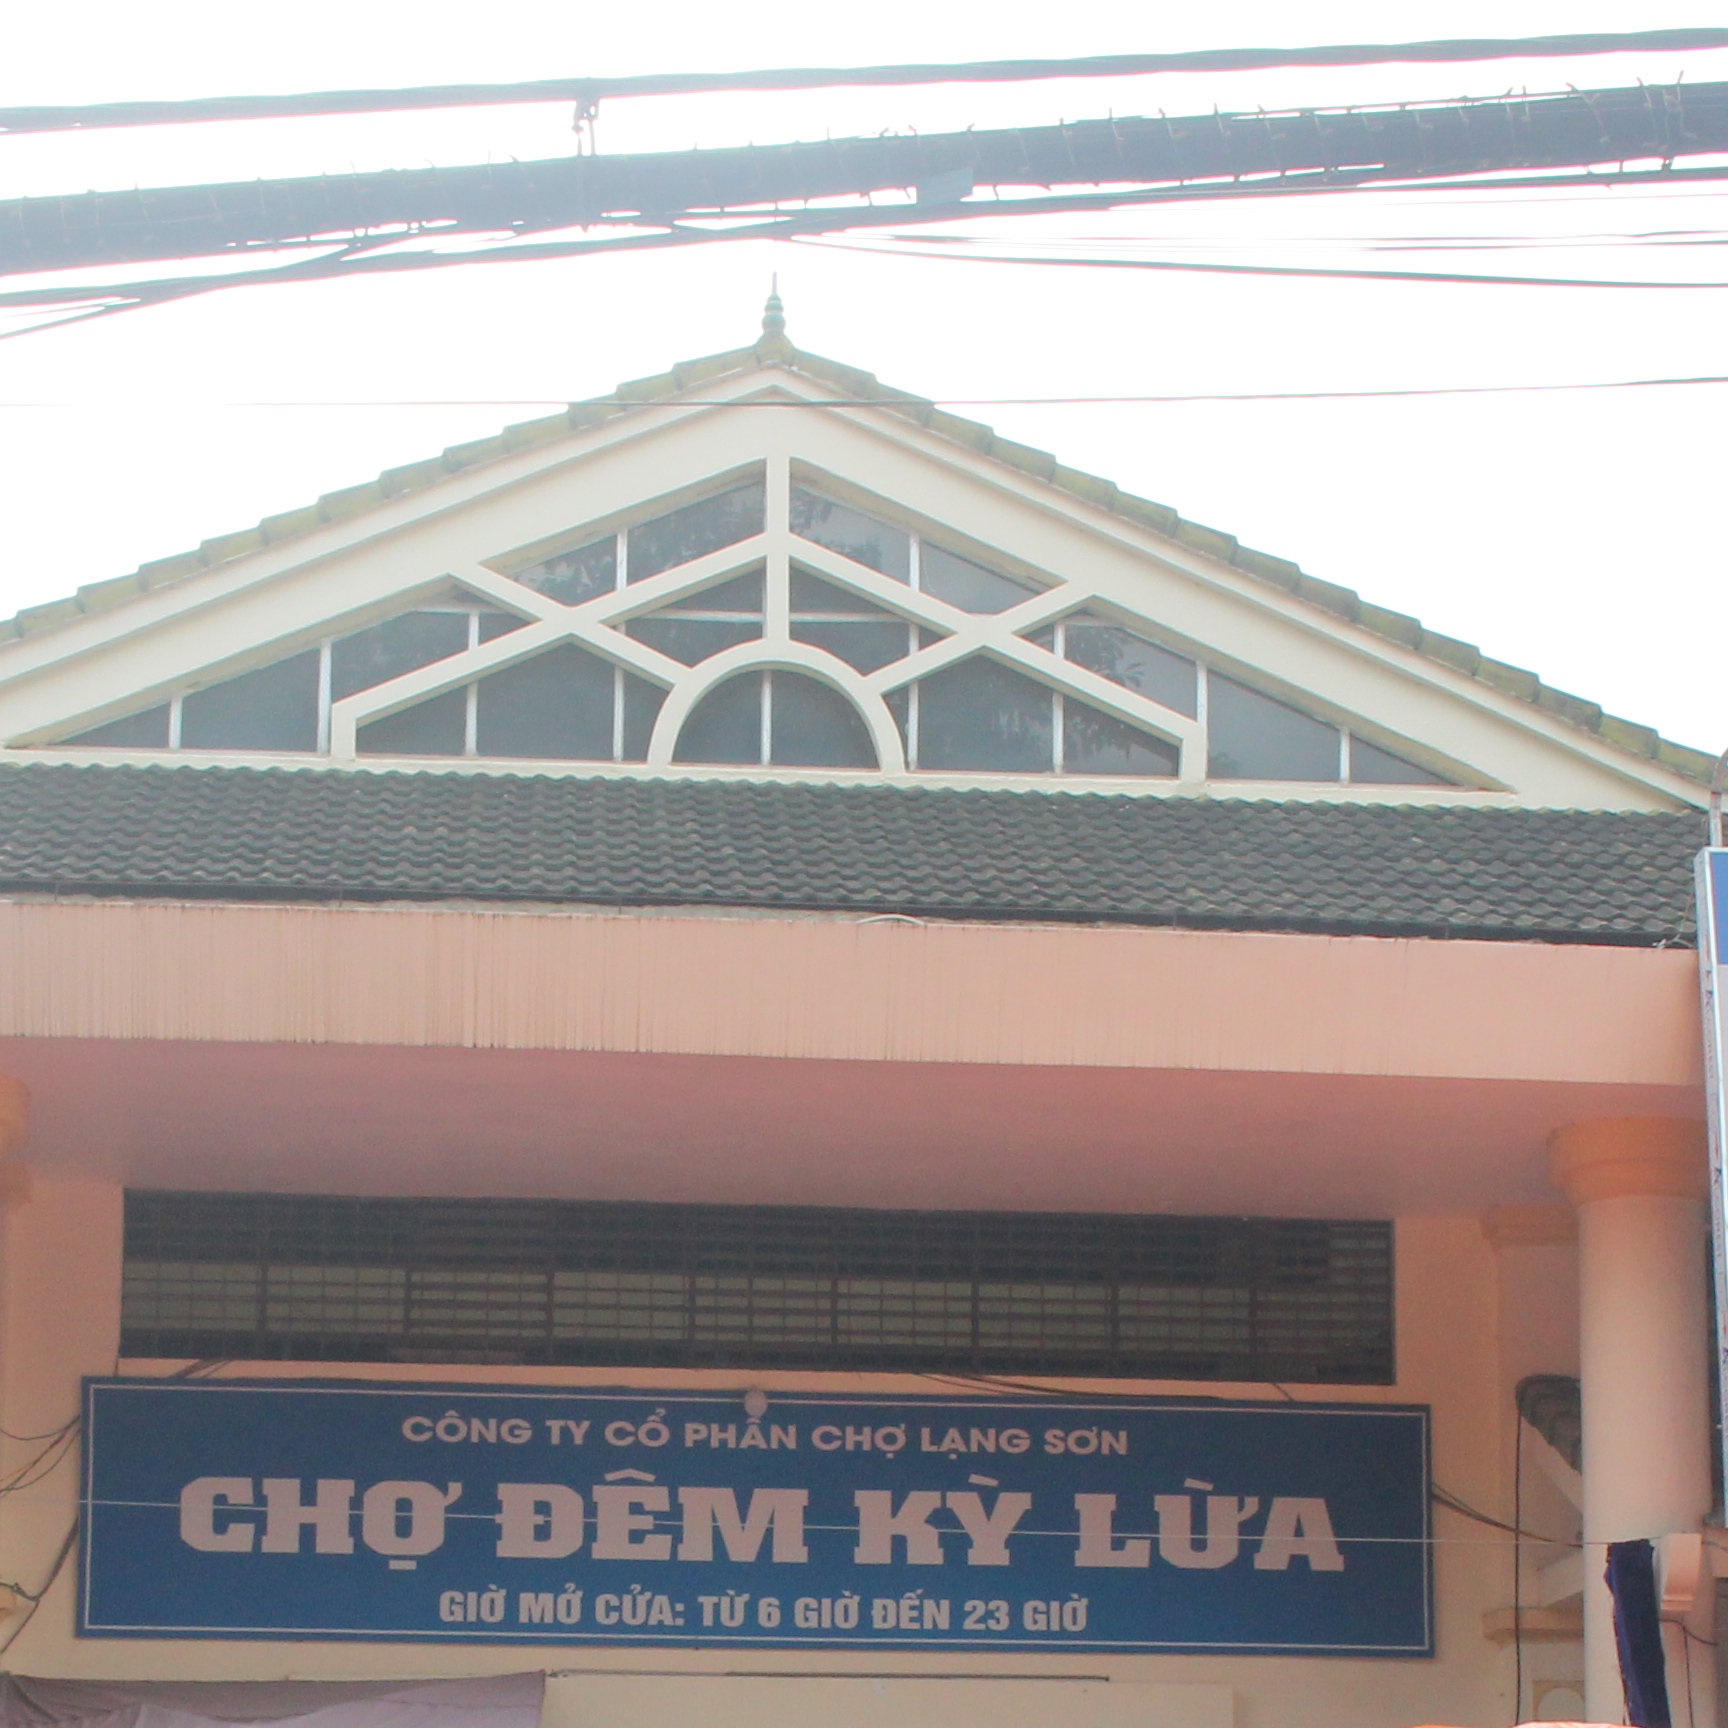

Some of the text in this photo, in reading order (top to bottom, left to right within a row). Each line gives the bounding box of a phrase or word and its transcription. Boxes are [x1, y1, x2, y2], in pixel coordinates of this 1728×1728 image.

[402, 1410, 533, 1445] CÔNG
[545, 1419, 591, 1445] TY
[604, 1408, 670, 1447] CỔ
[811, 1423, 907, 1458] CHỢ
[921, 1427, 1030, 1459] LẠNG
[1044, 1426, 1128, 1455] SƠN
[179, 1468, 1346, 1571] CHỢ ĐÊM KỲ LỪA
[439, 1582, 1089, 1632] GIỜ MỞ CỬA: TỪ 6 GIỜ ĐẾN 23 GIỜ
